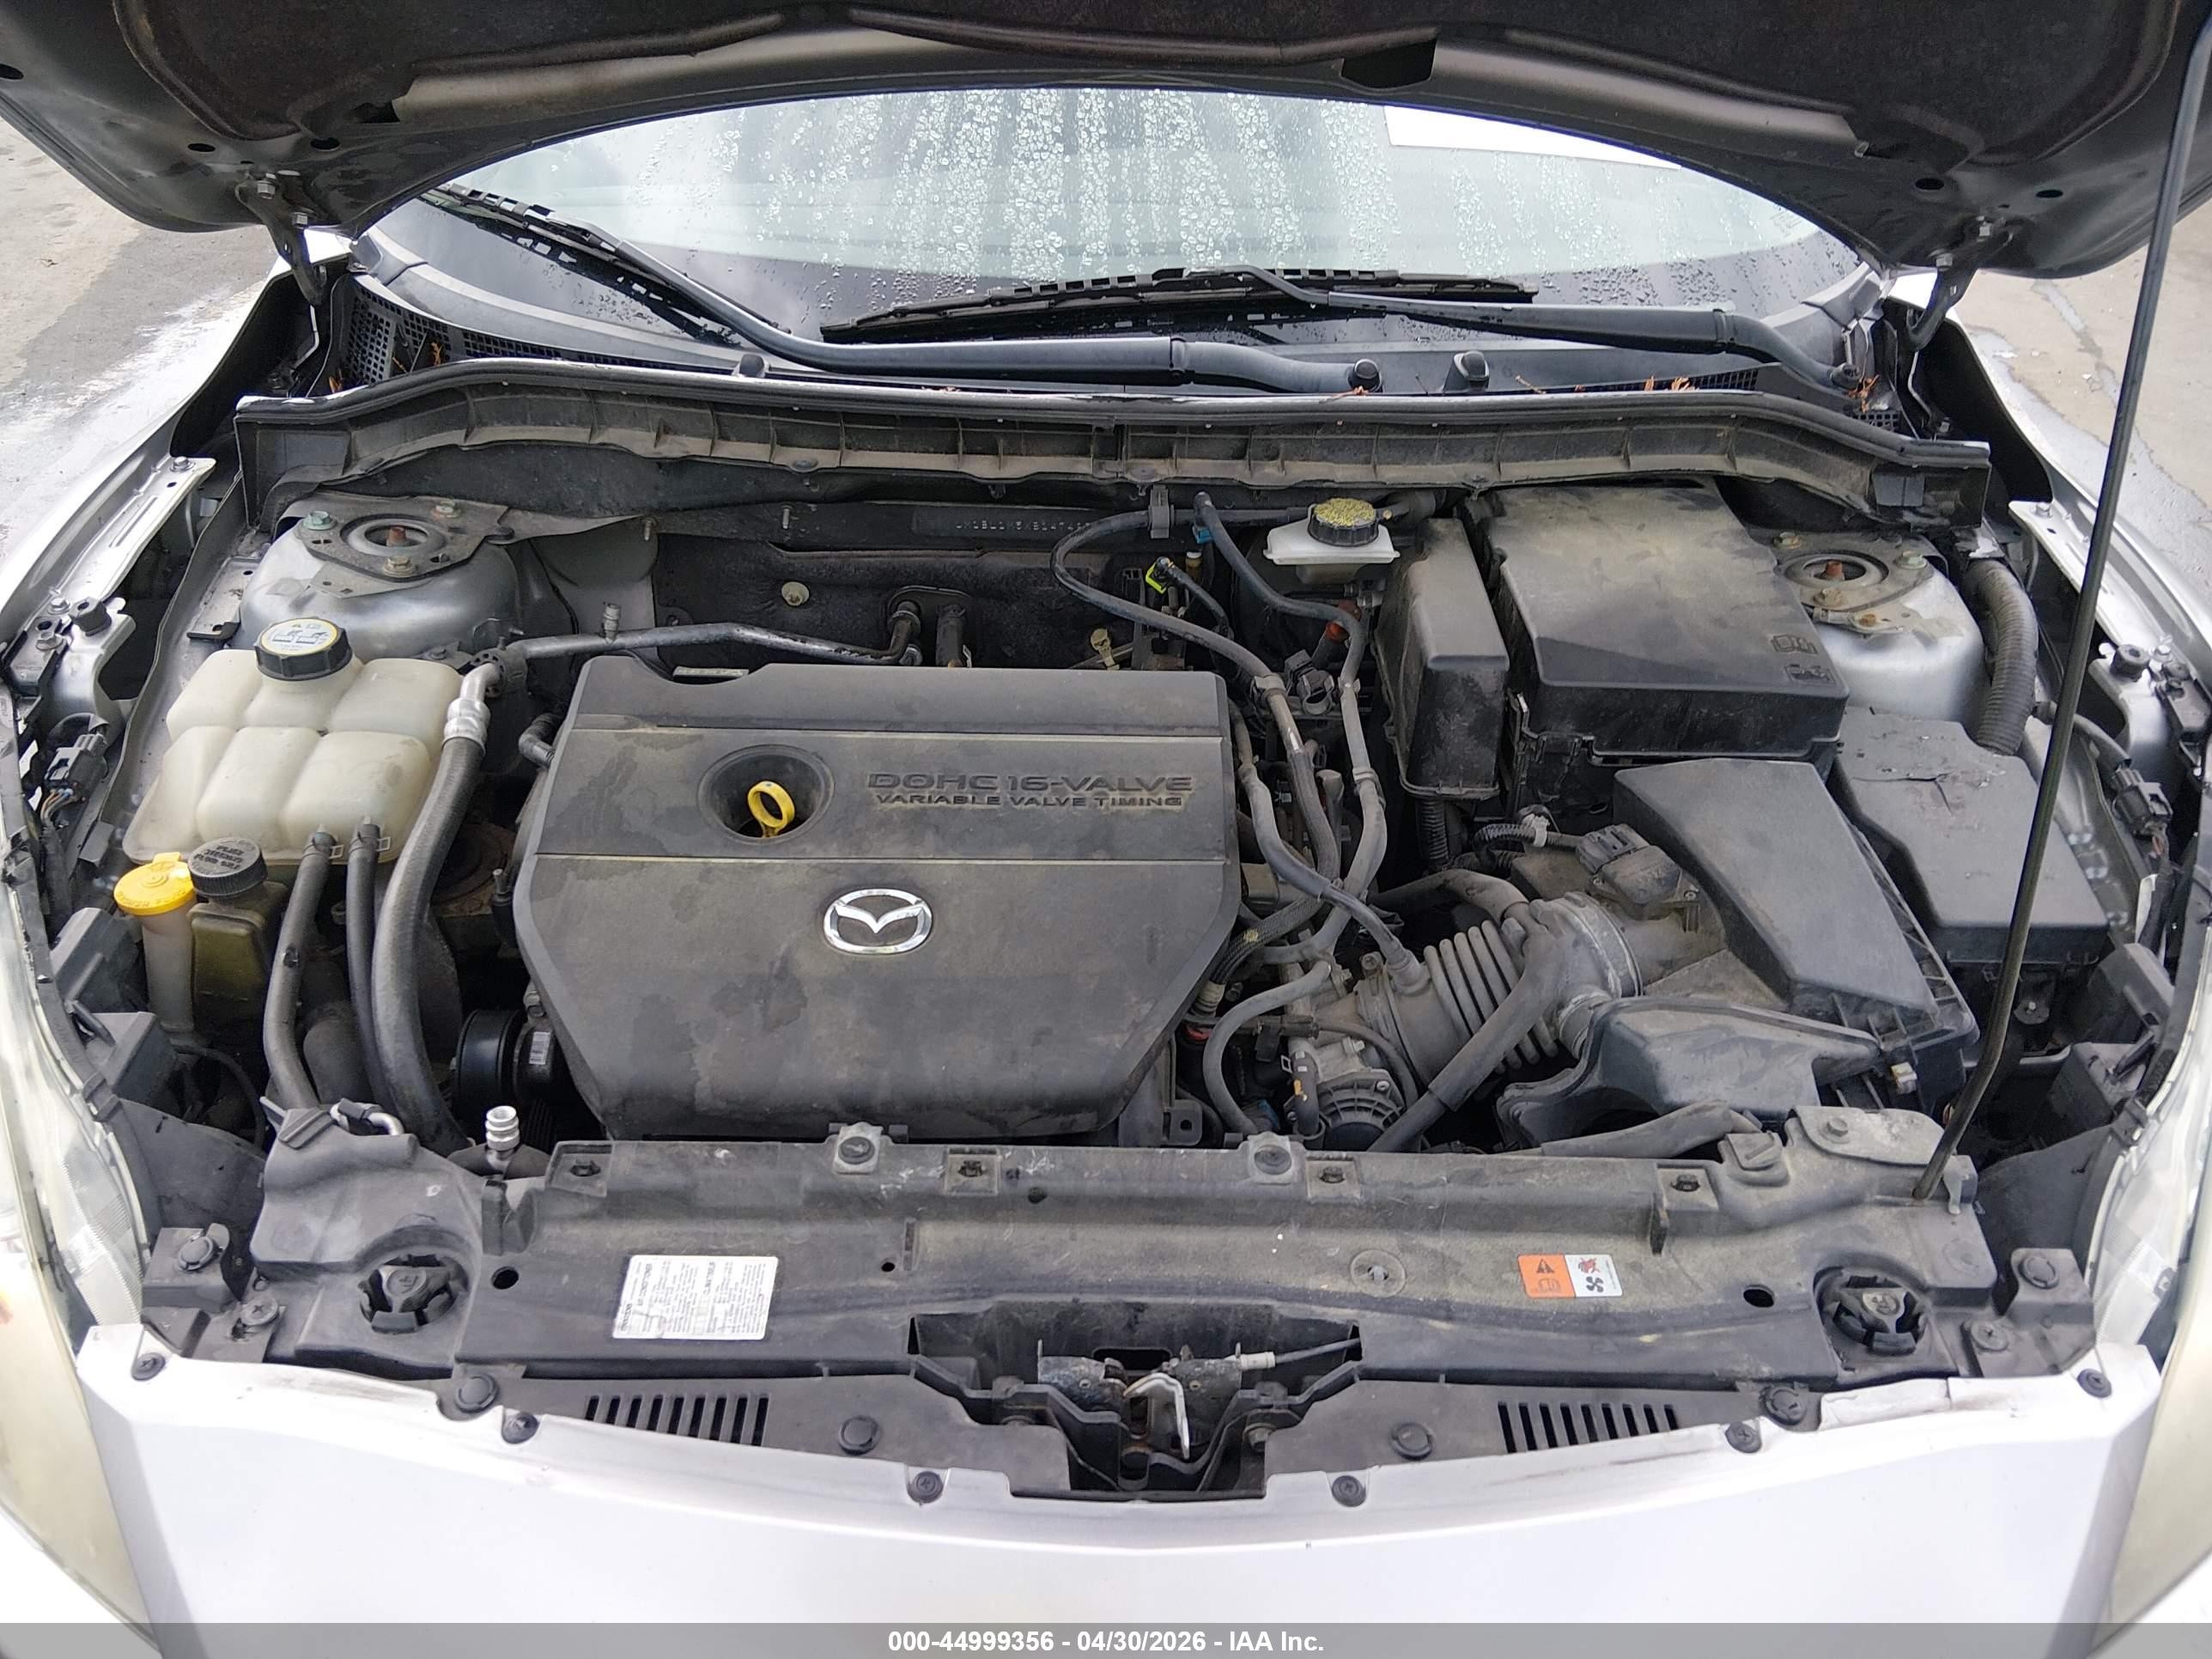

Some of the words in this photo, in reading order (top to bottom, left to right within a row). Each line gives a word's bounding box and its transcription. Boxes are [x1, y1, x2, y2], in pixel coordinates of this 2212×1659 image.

[868, 773, 997, 791] DOHC
[1007, 775, 1193, 792] 16-VALVE
[876, 793, 1001, 806] VARIABLE
[1010, 796, 1086, 807] VALVE
[1094, 797, 1182, 807] TIMING
